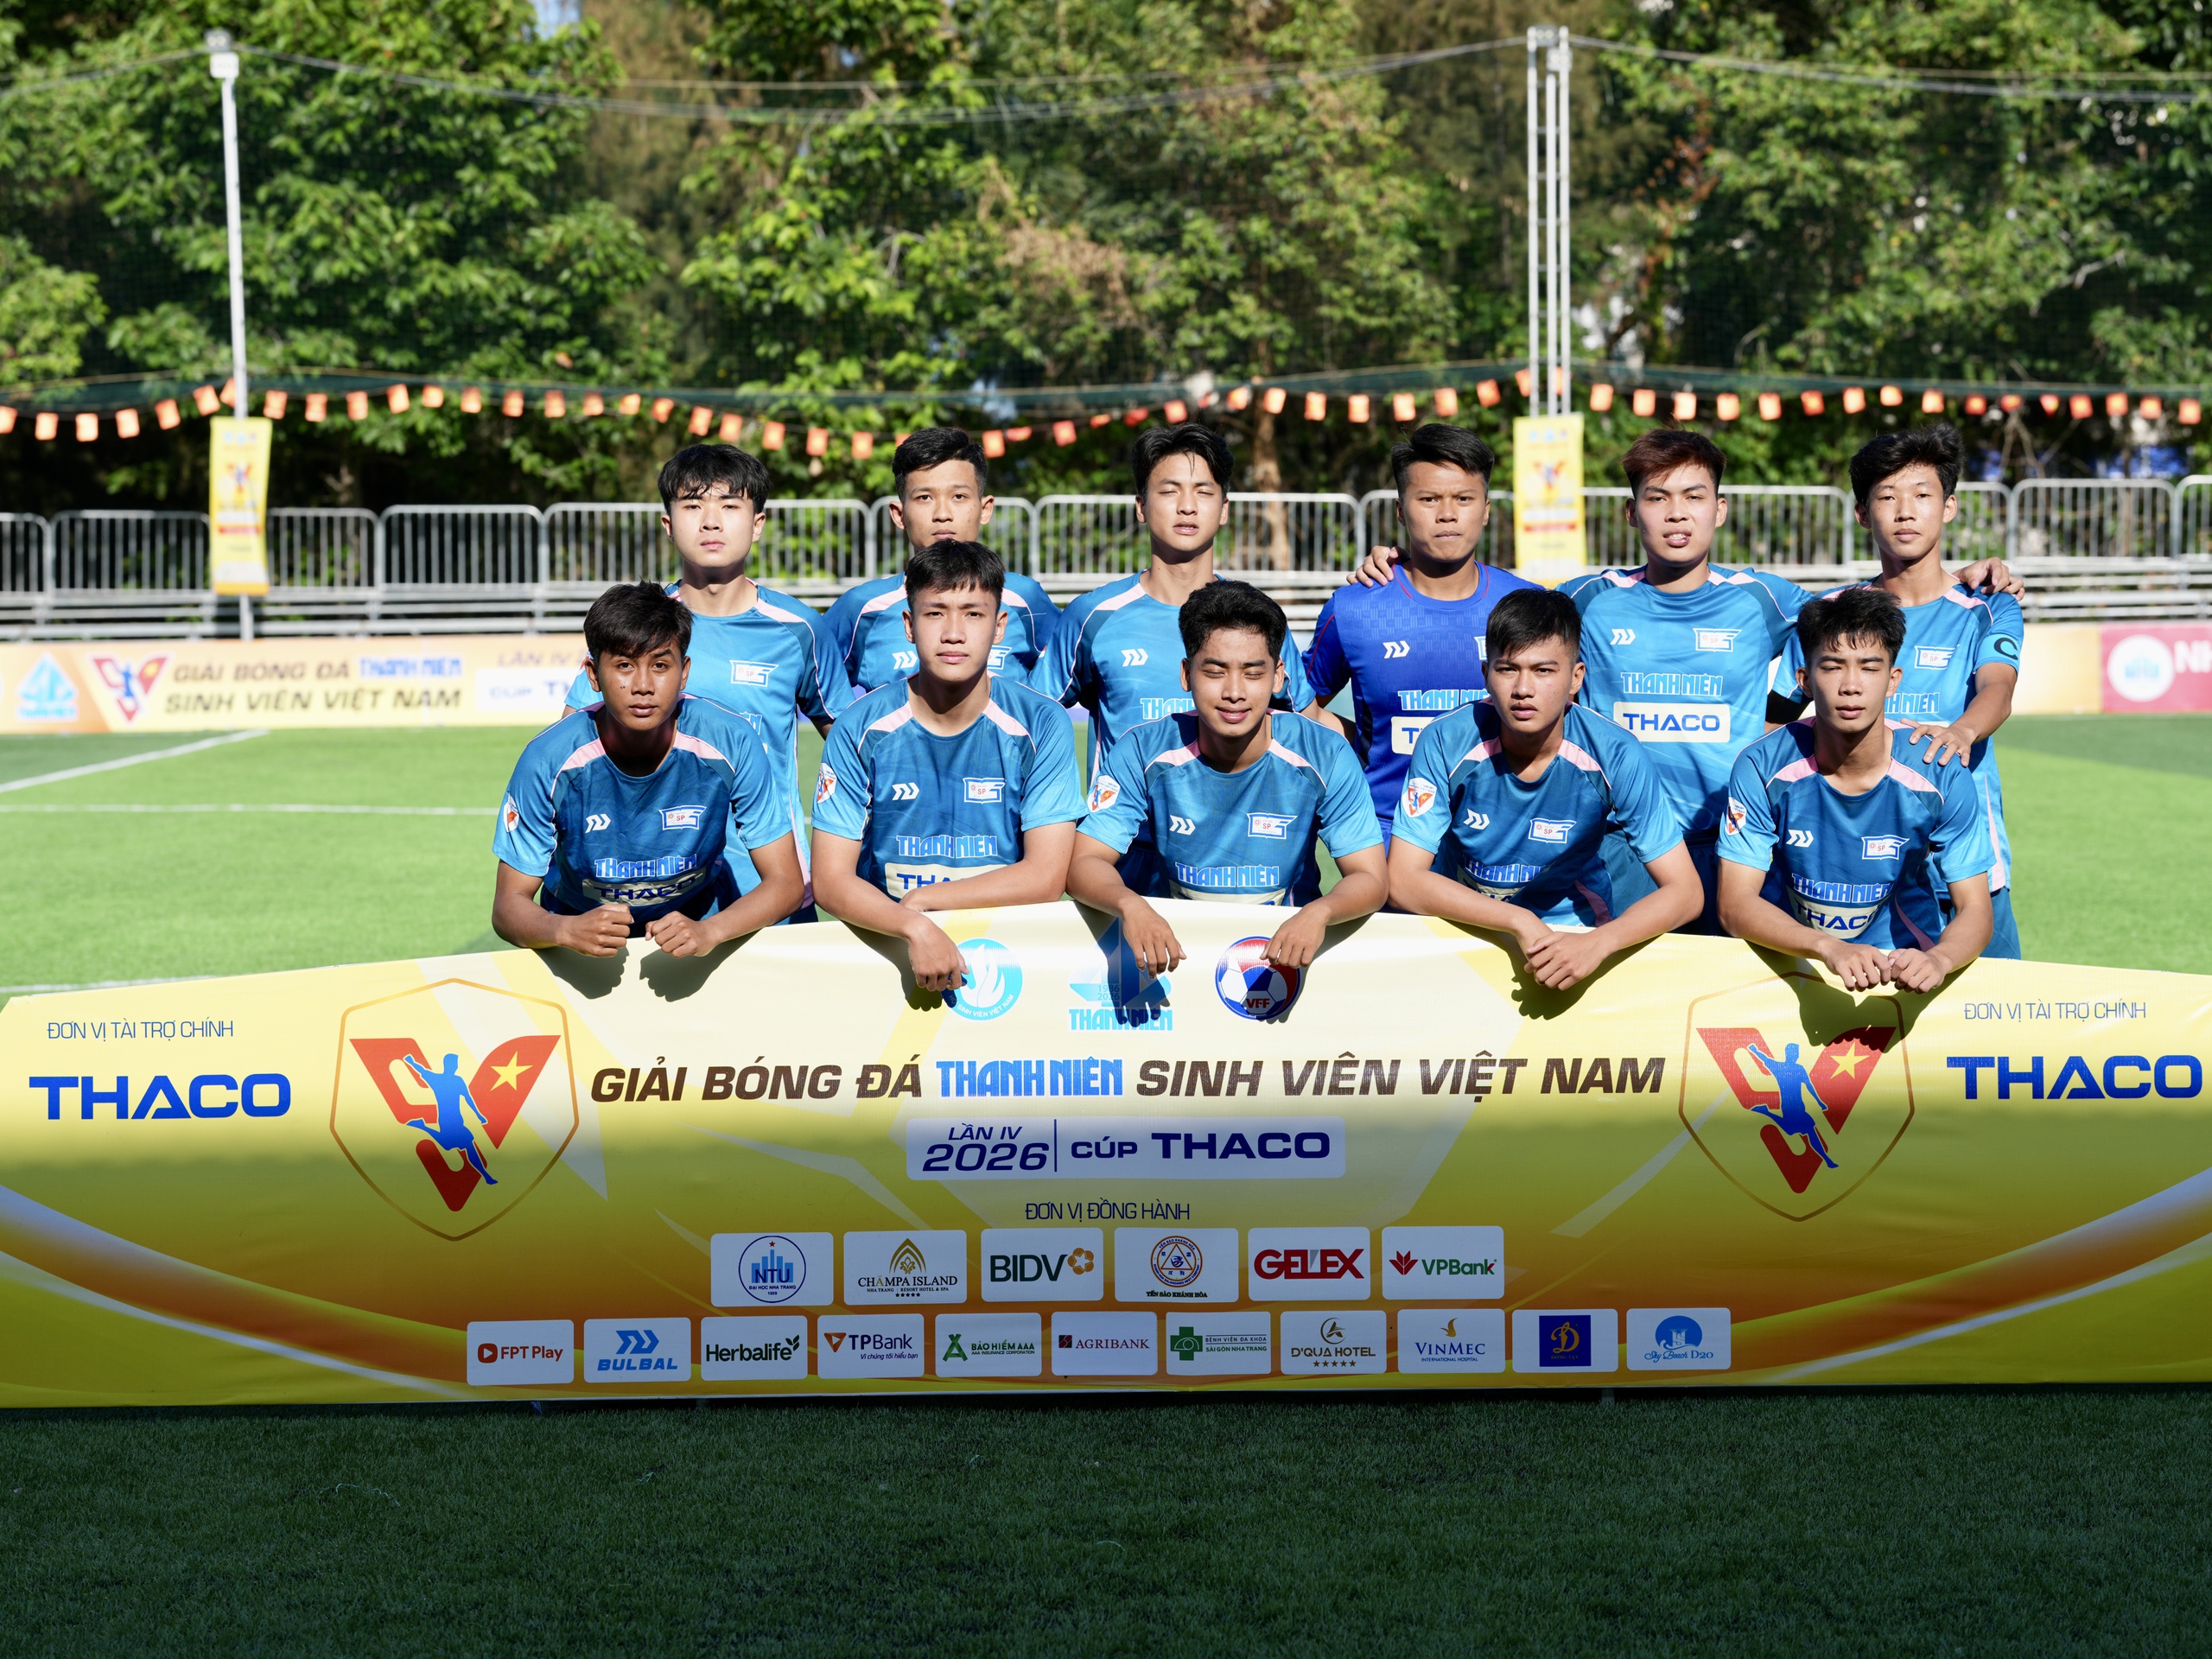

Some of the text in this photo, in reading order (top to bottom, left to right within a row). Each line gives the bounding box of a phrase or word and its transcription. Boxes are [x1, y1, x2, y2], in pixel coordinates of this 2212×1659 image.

[1993, 637, 2018, 660] C
[1620, 671, 1724, 696] THANH NIÊN
[391, 689, 461, 709] NAM
[1900, 692, 1941, 715] NIÊN
[1623, 712, 1721, 732] THACO
[896, 834, 998, 858] THANH NIÊN
[594, 854, 697, 878] THANH NIÊN
[1175, 861, 1279, 887] THANH NIÊN
[593, 873, 697, 899] THACO
[1791, 873, 1852, 903] THANH
[1097, 984, 1121, 993] 1986
[1097, 993, 1121, 1001] 2026
[957, 1004, 972, 1015] SINH
[1001, 994, 1014, 1008] NAM
[1245, 998, 1270, 1008] VFF
[1963, 998, 2147, 1023] ĐƠN VỊ TÀI TRỢ CHÍNH
[47, 1017, 234, 1043] ĐƠN VỊ TÀI TRỢ CHÍNH
[1069, 1008, 1128, 1031] THANH
[590, 1050, 1667, 1103] GIẢI BÓNG ĐÁ THANH NIÊN SINH VIÊN VIỆT NAM
[1946, 1054, 2203, 1100] THACO
[29, 1073, 291, 1121] THACO
[948, 1122, 1024, 1141] LẦN IV
[922, 1142, 1051, 1172] 2026
[1071, 1132, 1331, 1160] CÚP THACO
[1025, 1196, 1191, 1223] ĐƠN VỊ ĐỒNG HÀNH
[755, 1268, 790, 1284] NTU
[990, 1254, 1068, 1282] BIDV
[1253, 1248, 1365, 1281] GELEX
[1421, 1258, 1496, 1276] VPBank
[912, 1275, 958, 1287] ISLAND
[705, 1342, 792, 1363] Herbalife
[848, 1333, 913, 1351] TPBank
[971, 1340, 990, 1351] BẢO
[991, 1338, 1016, 1351] HIỂM
[1075, 1338, 1150, 1350] AGRIBANK
[1291, 1346, 1376, 1357] D'QUA HOTEL
[501, 1344, 564, 1364] FPT Play
[597, 1358, 678, 1371] BULBAL
[1644, 1350, 1714, 1363] Sky Beach D20
